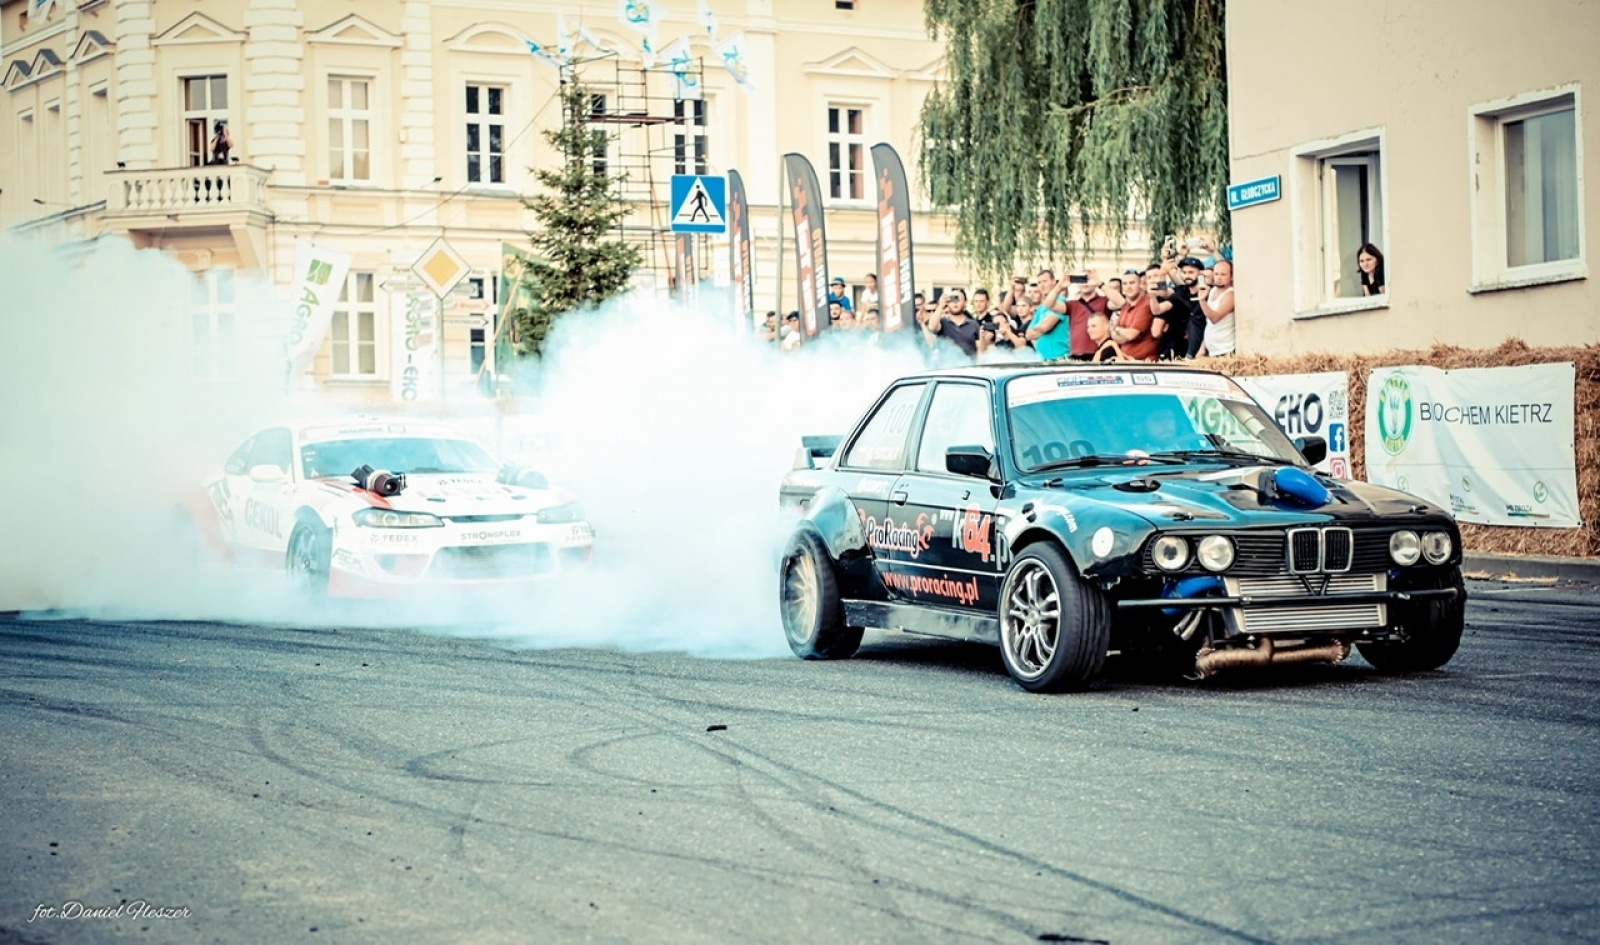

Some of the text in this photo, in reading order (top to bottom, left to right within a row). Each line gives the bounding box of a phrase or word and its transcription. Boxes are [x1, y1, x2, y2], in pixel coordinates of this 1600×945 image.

[1275, 392, 1323, 434] EKO
[1495, 403, 1553, 424] KIETRZ
[866, 517, 920, 559] ProRacing
[882, 569, 980, 606] www.proracing.pl
